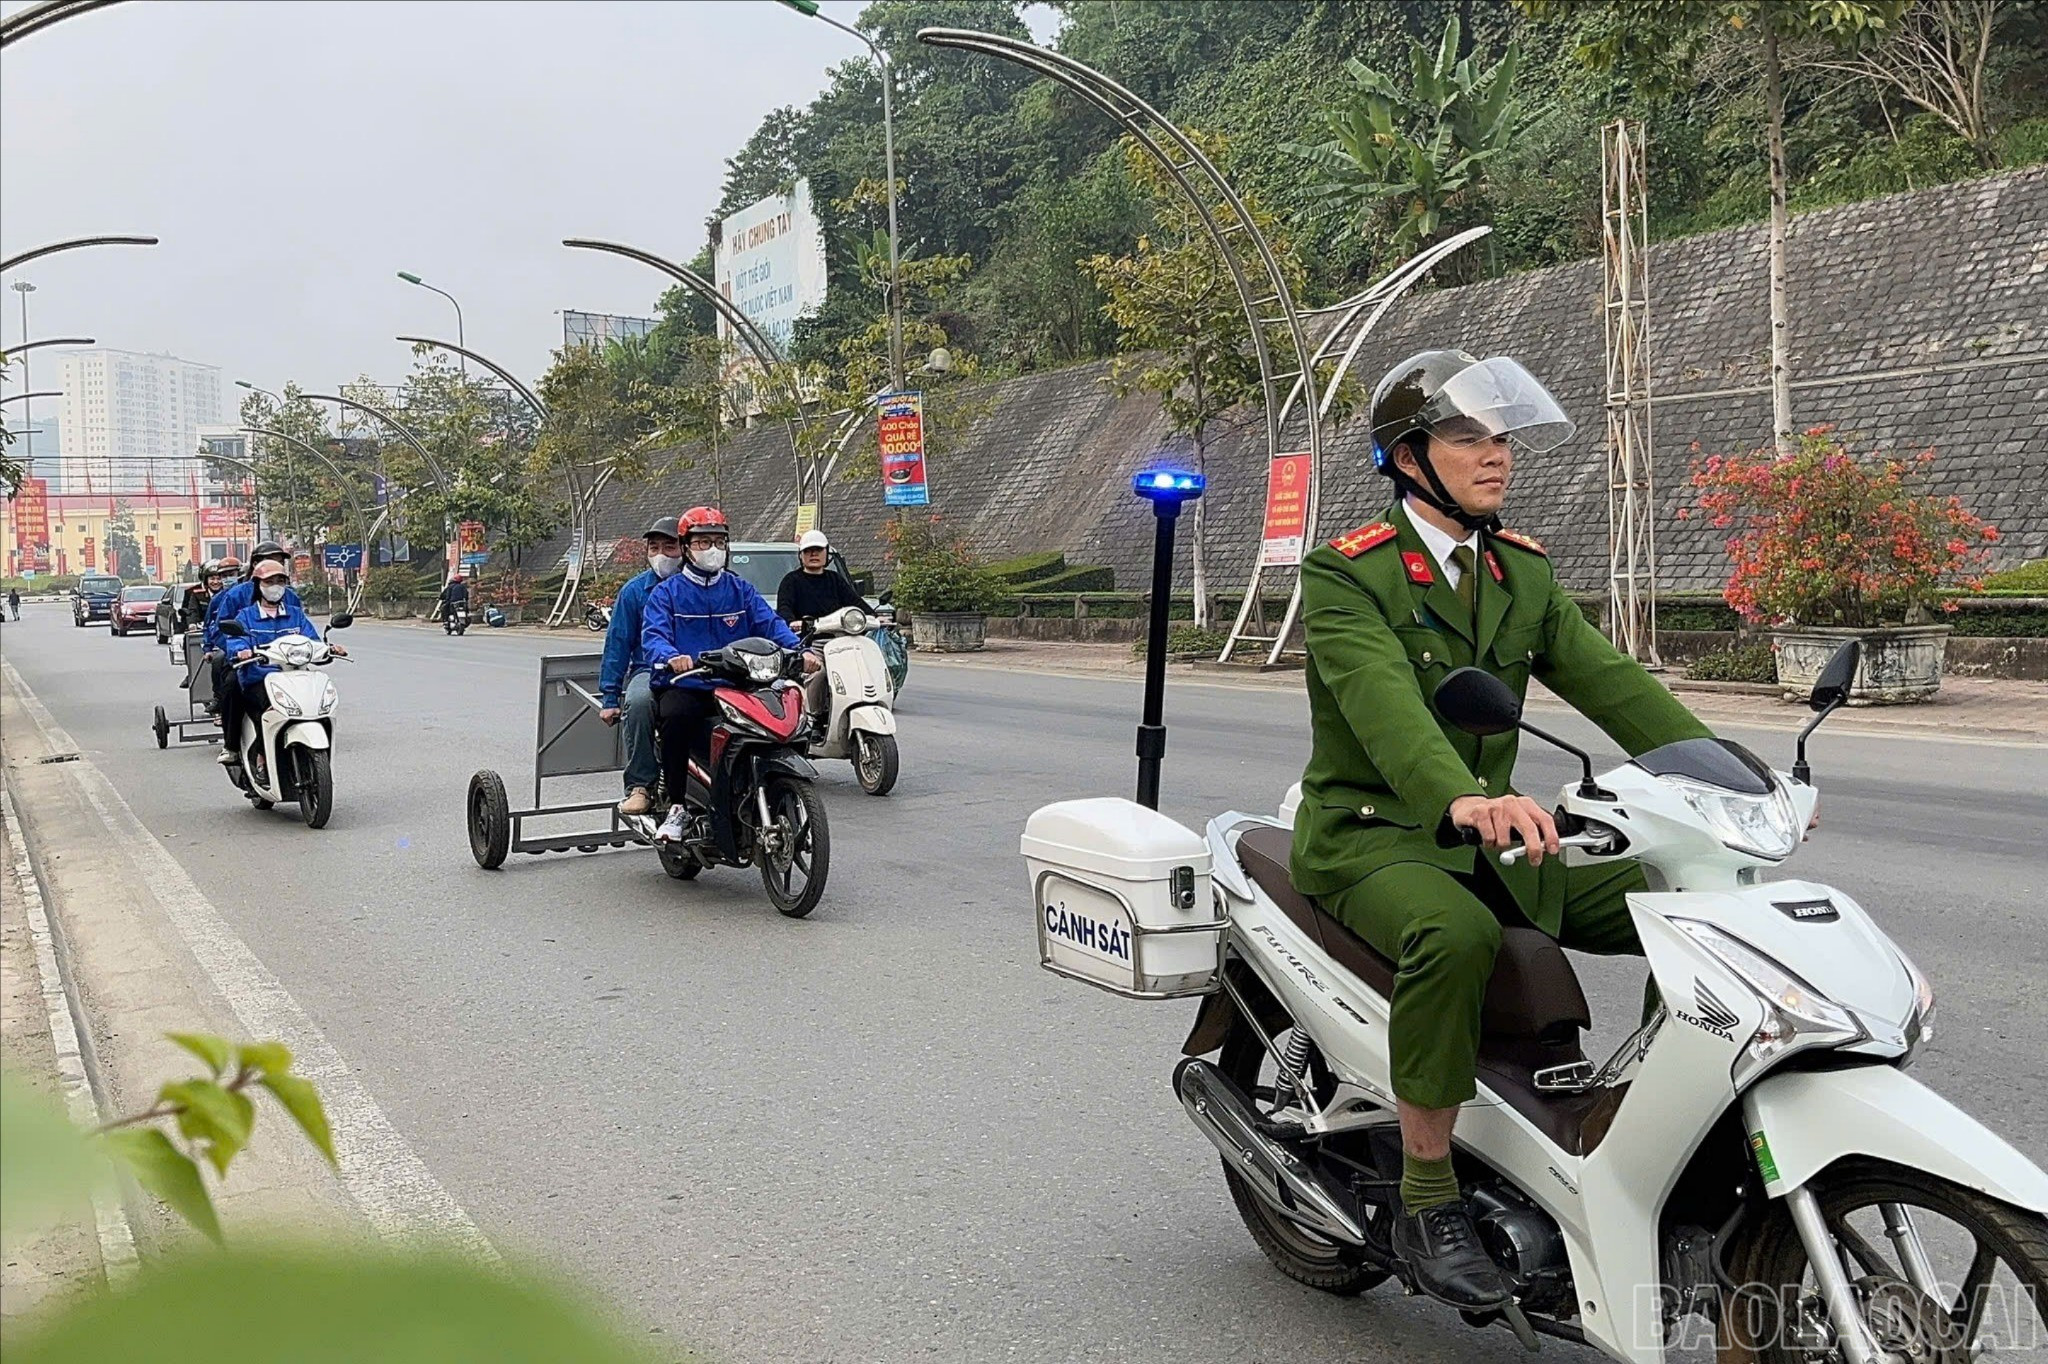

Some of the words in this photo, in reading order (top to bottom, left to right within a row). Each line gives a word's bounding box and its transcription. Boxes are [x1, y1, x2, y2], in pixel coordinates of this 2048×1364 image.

[748, 218, 775, 249] CHUNG
[777, 211, 792, 236] TAY
[778, 284, 793, 305] NAM
[881, 422, 897, 431] 400
[1046, 901, 1096, 949] CẢNH
[1098, 919, 1131, 961] SÁT
[1675, 1009, 1735, 1043] HONDA
